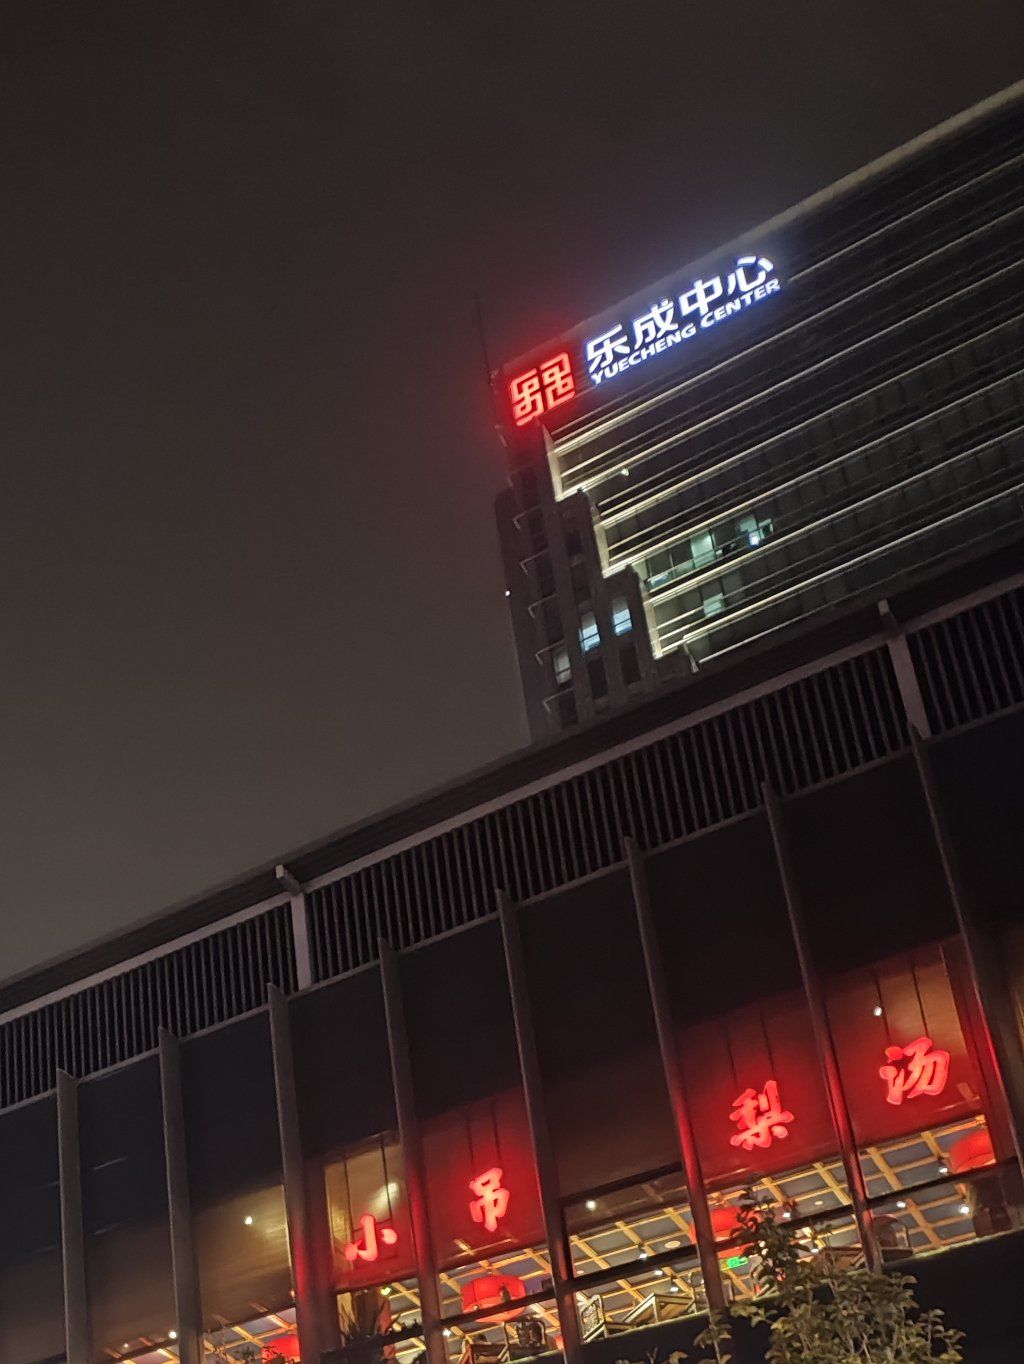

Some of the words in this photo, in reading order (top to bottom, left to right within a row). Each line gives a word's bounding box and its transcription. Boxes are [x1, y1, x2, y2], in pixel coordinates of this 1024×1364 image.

[585, 255, 774, 374] 乐成中心
[590, 323, 696, 386] YUECHENG
[699, 278, 780, 329] CENTER
